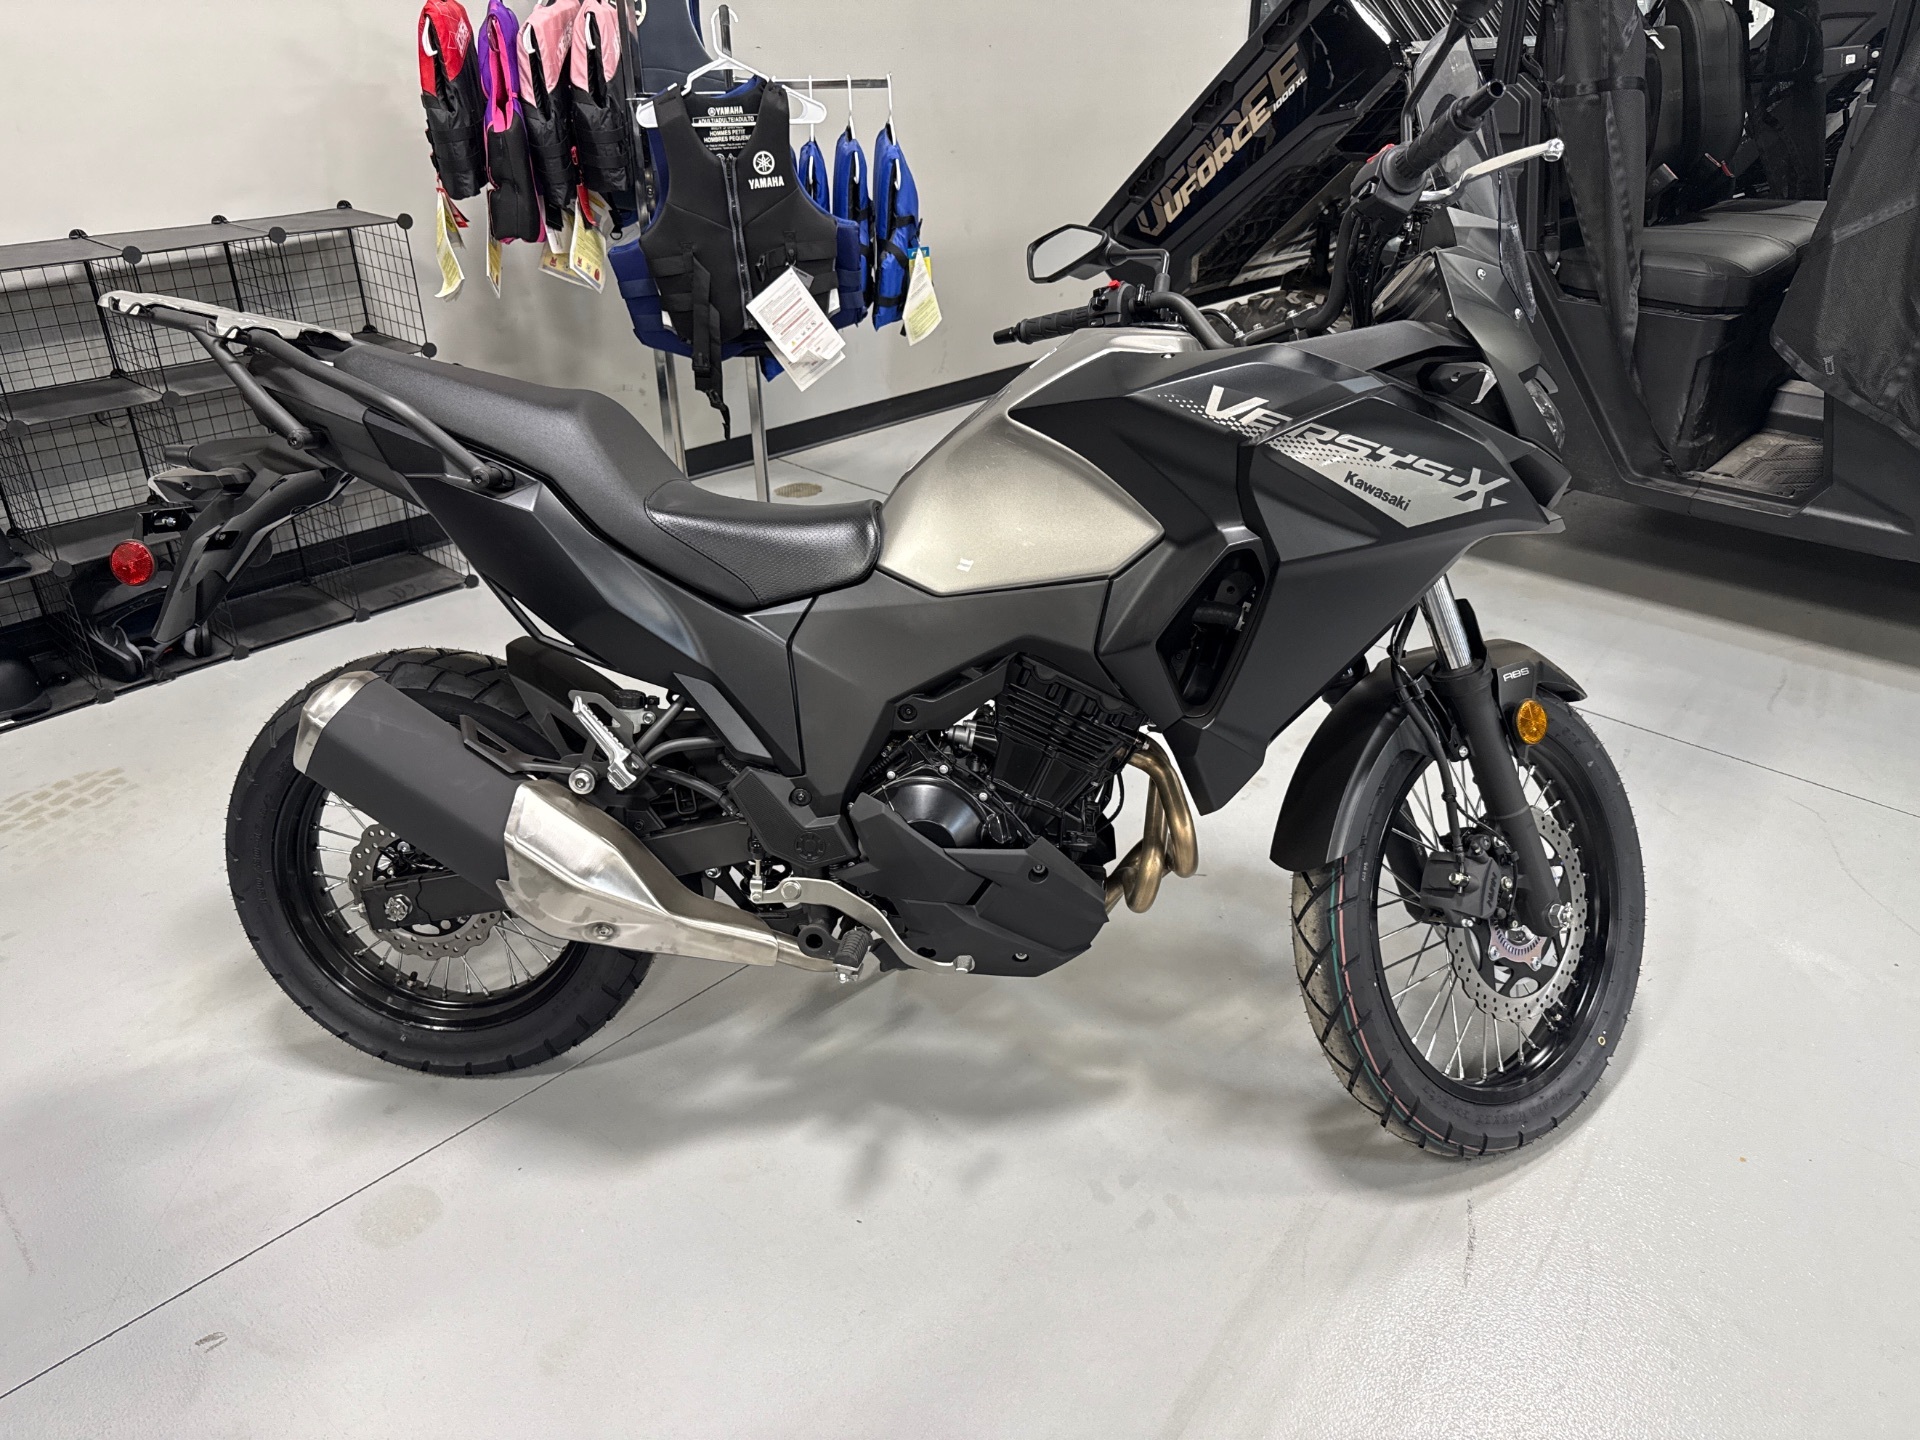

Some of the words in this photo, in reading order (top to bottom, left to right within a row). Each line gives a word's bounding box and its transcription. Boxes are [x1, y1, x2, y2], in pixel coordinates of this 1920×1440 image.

[715, 106, 743, 115] YAMAHA
[709, 129, 732, 137] HOMMES
[1163, 95, 1271, 223] UFORCE
[1272, 83, 1296, 113] 1000
[1294, 75, 1308, 89] XL
[748, 176, 785, 190] YAMAHA
[1343, 470, 1412, 512] Kawasaki
[1502, 667, 1530, 682] ABS
